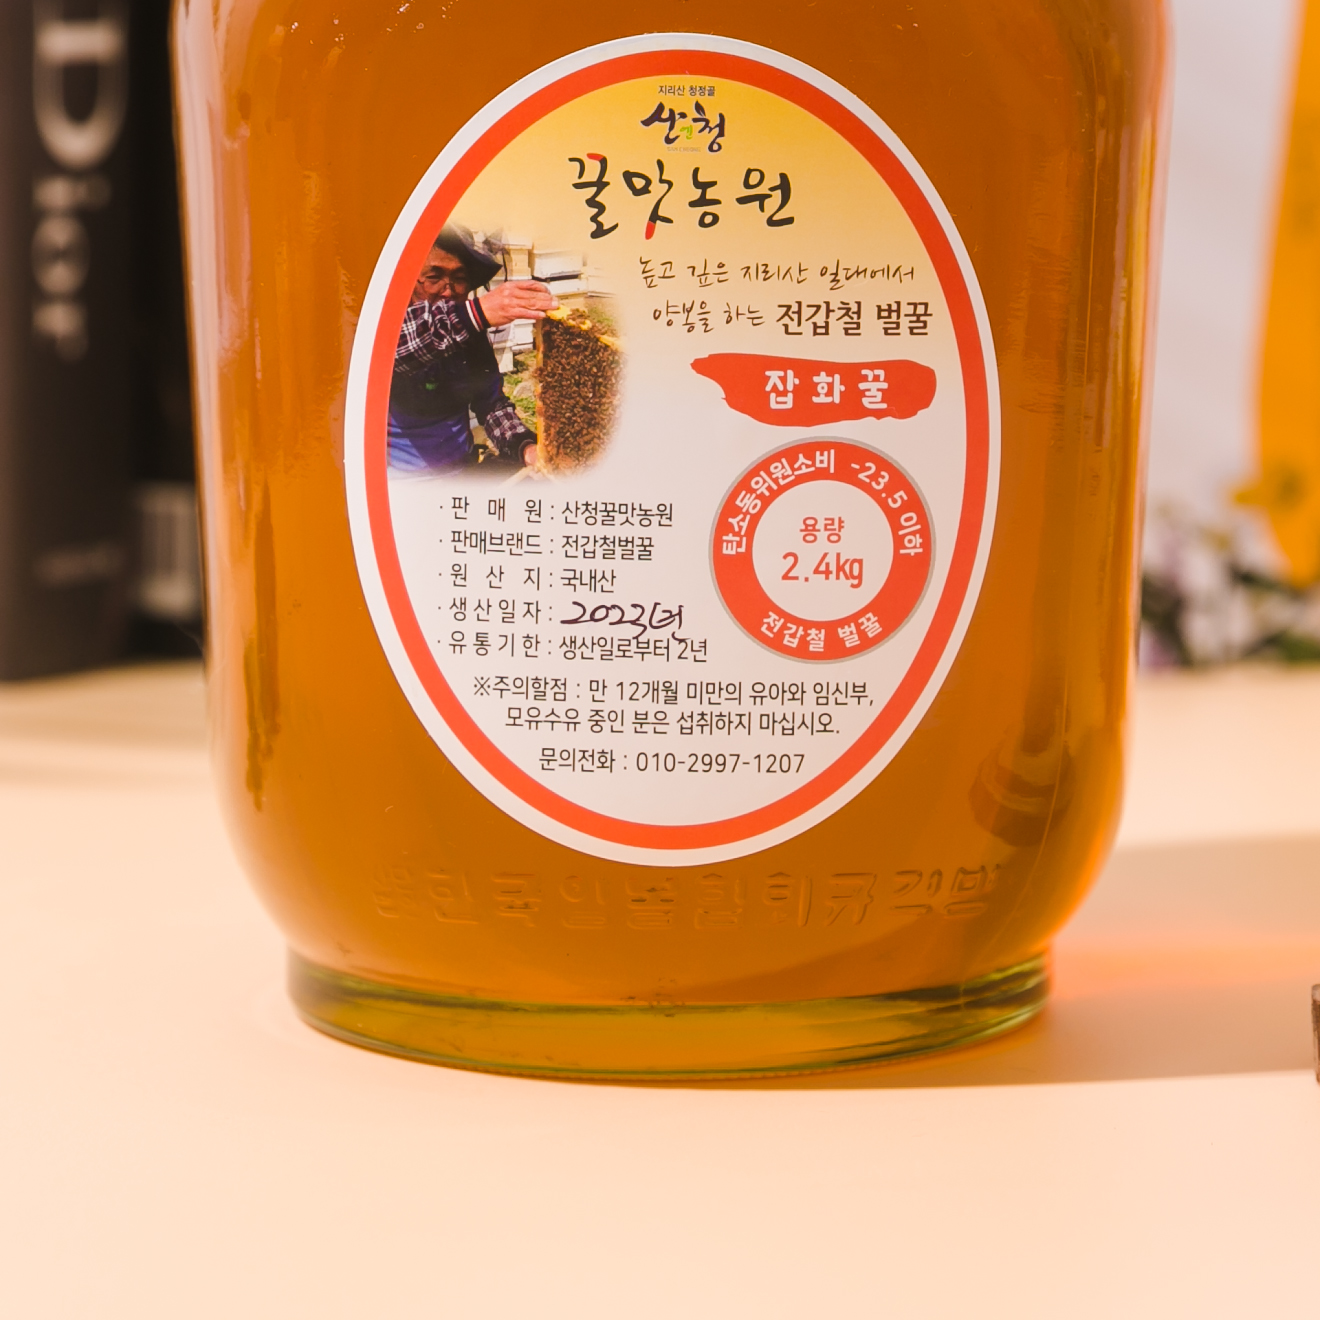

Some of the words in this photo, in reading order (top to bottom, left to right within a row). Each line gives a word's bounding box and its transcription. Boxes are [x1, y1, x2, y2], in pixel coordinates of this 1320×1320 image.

[658, 85, 686, 96] 지리산
[689, 85, 716, 97] 청정골
[34, 2, 129, 360] Dior
[568, 152, 795, 240] 꿀맛농원
[639, 256, 676, 288] 높고
[686, 258, 730, 288] 깊은
[740, 262, 809, 284] 지리산
[819, 258, 915, 291] 일대에서
[652, 299, 714, 333] 양봉을
[723, 302, 765, 326] 하는
[776, 300, 862, 336] 전갑철
[875, 300, 933, 336] 벌꿀
[561, 500, 674, 528] 산청꿀맛농원
[722, 449, 835, 556] 탄소동위원소비
[850, 462, 908, 509] -23.5
[897, 512, 924, 556] 이하
[799, 516, 845, 544] 용량
[451, 530, 543, 556] 판매브랜드
[561, 535, 655, 561] 전갑철벌꿀
[560, 568, 617, 594] 국내산
[781, 551, 864, 589] 2.4kg
[760, 611, 825, 653] 전갑철
[837, 612, 883, 648] 벌꿀
[559, 634, 671, 662] 생산일로부터
[677, 637, 708, 663] 2년
[589, 679, 608, 703] 만
[616, 680, 679, 705] 12개월
[687, 681, 742, 706] 미만의
[749, 681, 807, 706] 유아와
[813, 681, 874, 707] 임신부,
[505, 706, 581, 732] 모유수유
[588, 709, 625, 733] 중인
[632, 710, 670, 735] 분은
[676, 711, 751, 736] 섭취하지
[759, 711, 840, 736] 마십시오.
[539, 747, 616, 773] 문의전화
[636, 751, 805, 774] 010-2997-1207
